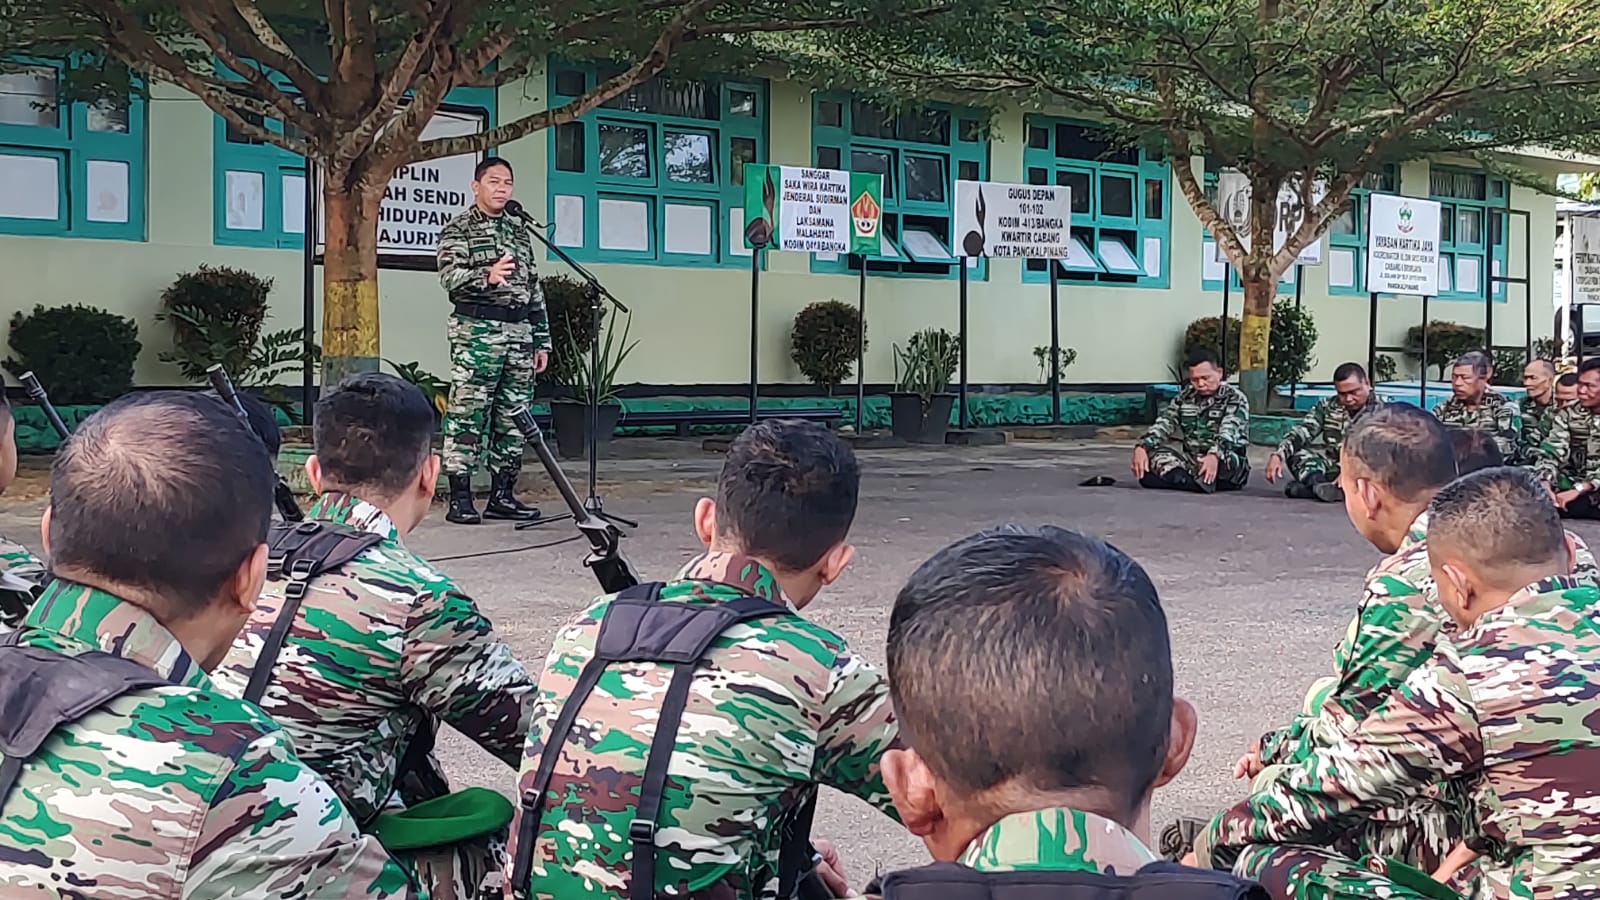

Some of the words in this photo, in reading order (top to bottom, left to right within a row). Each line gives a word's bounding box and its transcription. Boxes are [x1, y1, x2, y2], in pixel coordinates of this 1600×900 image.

[393, 165, 439, 183] IPLIN
[801, 169, 830, 180] SANGGAR
[784, 179, 801, 189] SAKA
[803, 181, 818, 191] WIRA
[819, 182, 846, 193] KARTIKA
[382, 186, 406, 201] AH
[413, 188, 465, 206] SENDI
[783, 191, 814, 203] JENDERAL
[816, 194, 848, 205] SUDIRMAN
[1008, 188, 1031, 200] GUGUS
[1032, 189, 1055, 202] DEPAN
[809, 205, 822, 215] DAN
[1019, 203, 1044, 215] 101-102
[379, 207, 452, 226] HIDUPAN
[796, 216, 834, 228] LAKSAMANA
[998, 216, 1020, 228] KODIM
[379, 229, 440, 245] AJURI
[796, 228, 835, 240] MALAHAYATI
[1001, 231, 1031, 243] KWARTIR
[1033, 232, 1060, 243] CABANG
[993, 245, 1011, 257] KOTA
[1013, 246, 1068, 257] PANGKALPINANG
